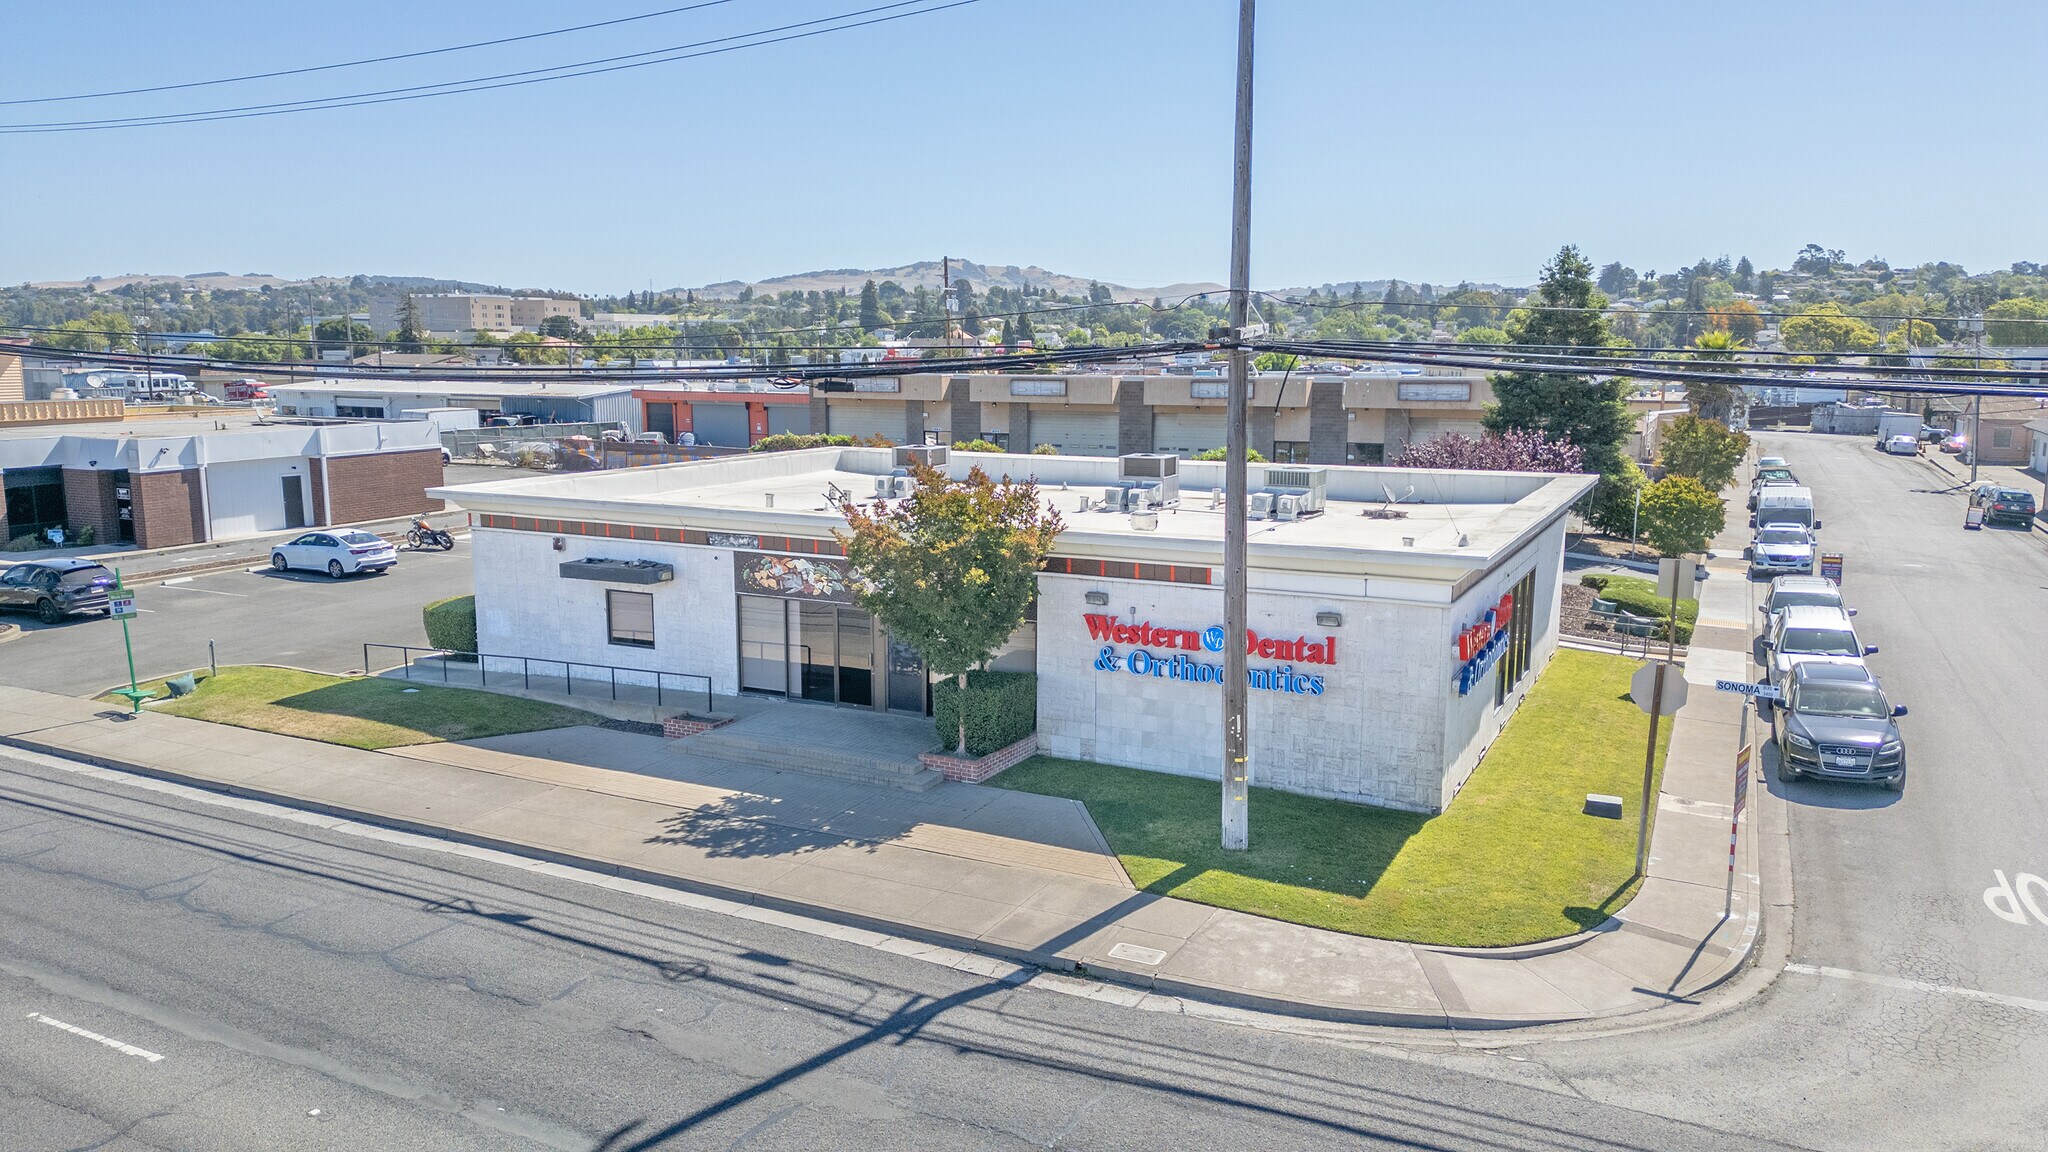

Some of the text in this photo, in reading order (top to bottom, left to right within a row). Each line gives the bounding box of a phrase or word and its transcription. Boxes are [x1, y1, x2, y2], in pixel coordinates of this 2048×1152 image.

[1083, 613, 1201, 651] Western
[1094, 645, 1121, 673] &
[1717, 681, 1760, 694] SONOMA
